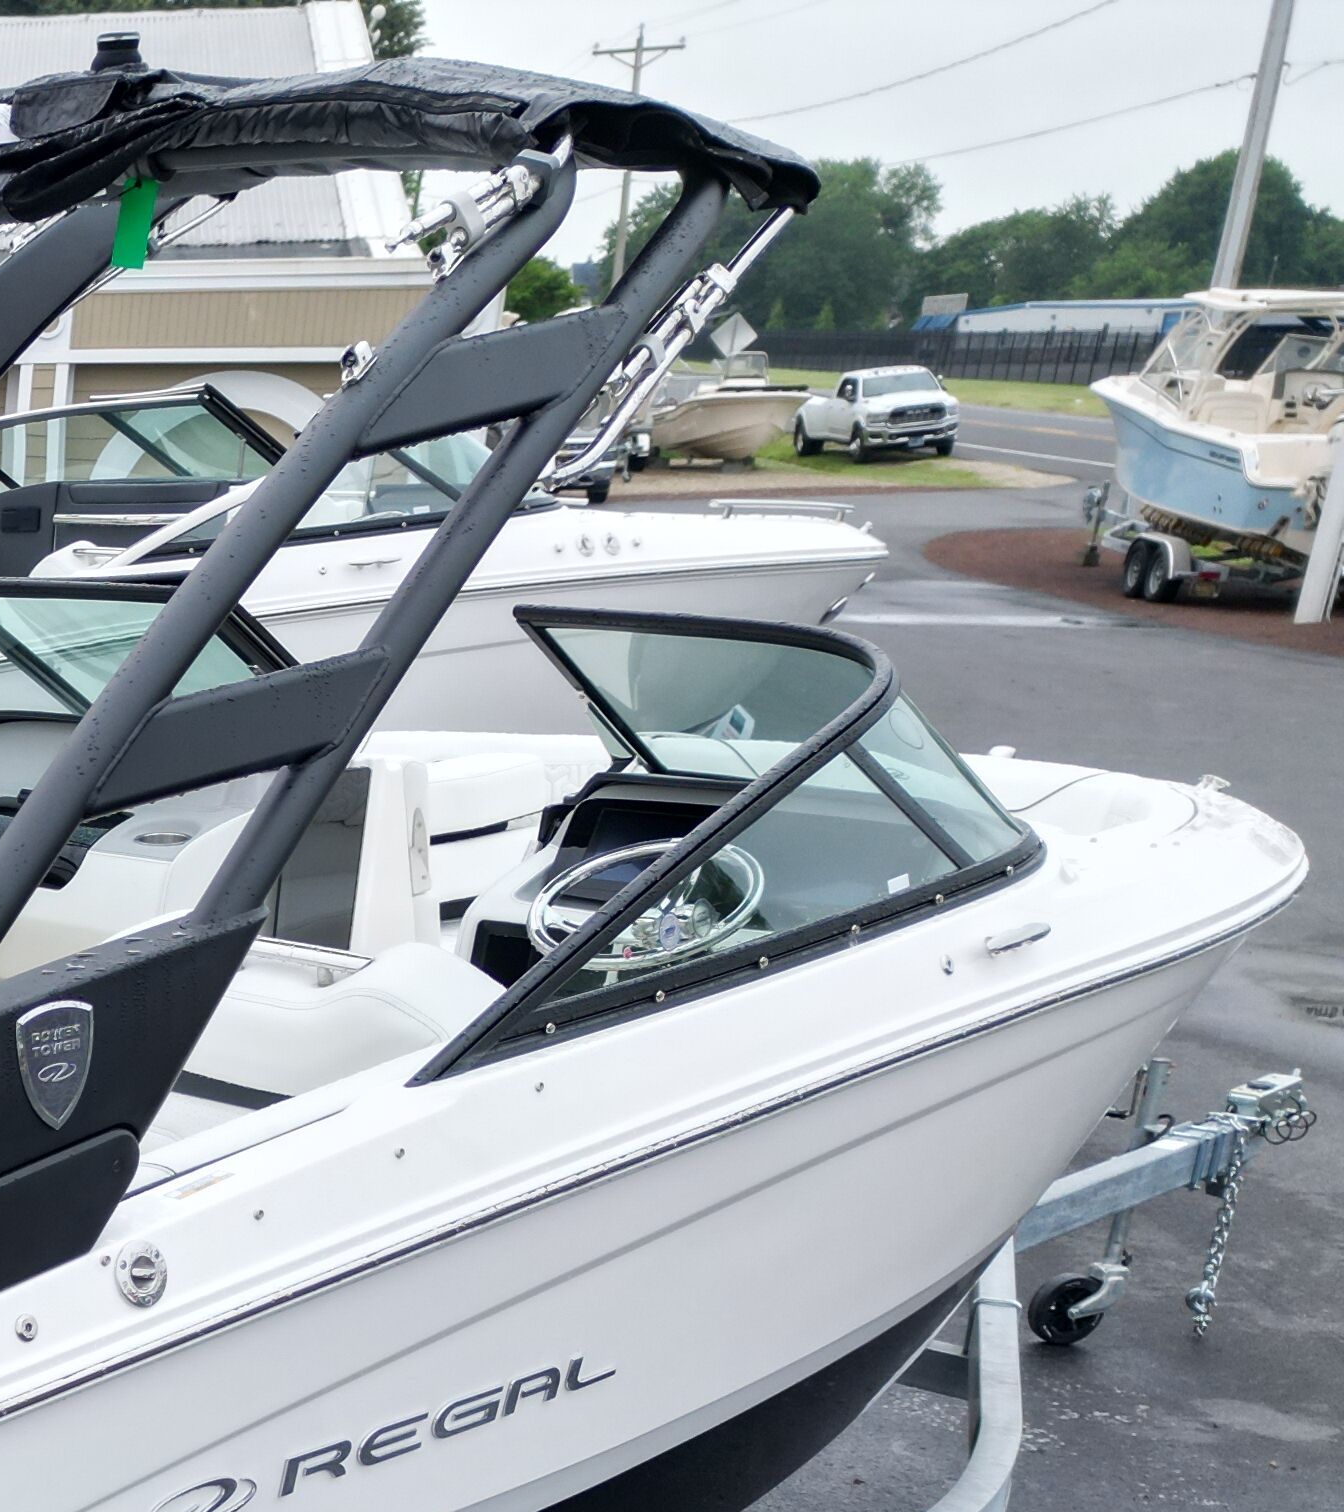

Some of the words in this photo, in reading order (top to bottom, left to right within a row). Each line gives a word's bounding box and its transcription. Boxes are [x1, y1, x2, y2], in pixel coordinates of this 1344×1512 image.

[31, 1023, 81, 1043] POWER
[31, 1038, 81, 1058] TOWER
[278, 1353, 617, 1498] REGAL
